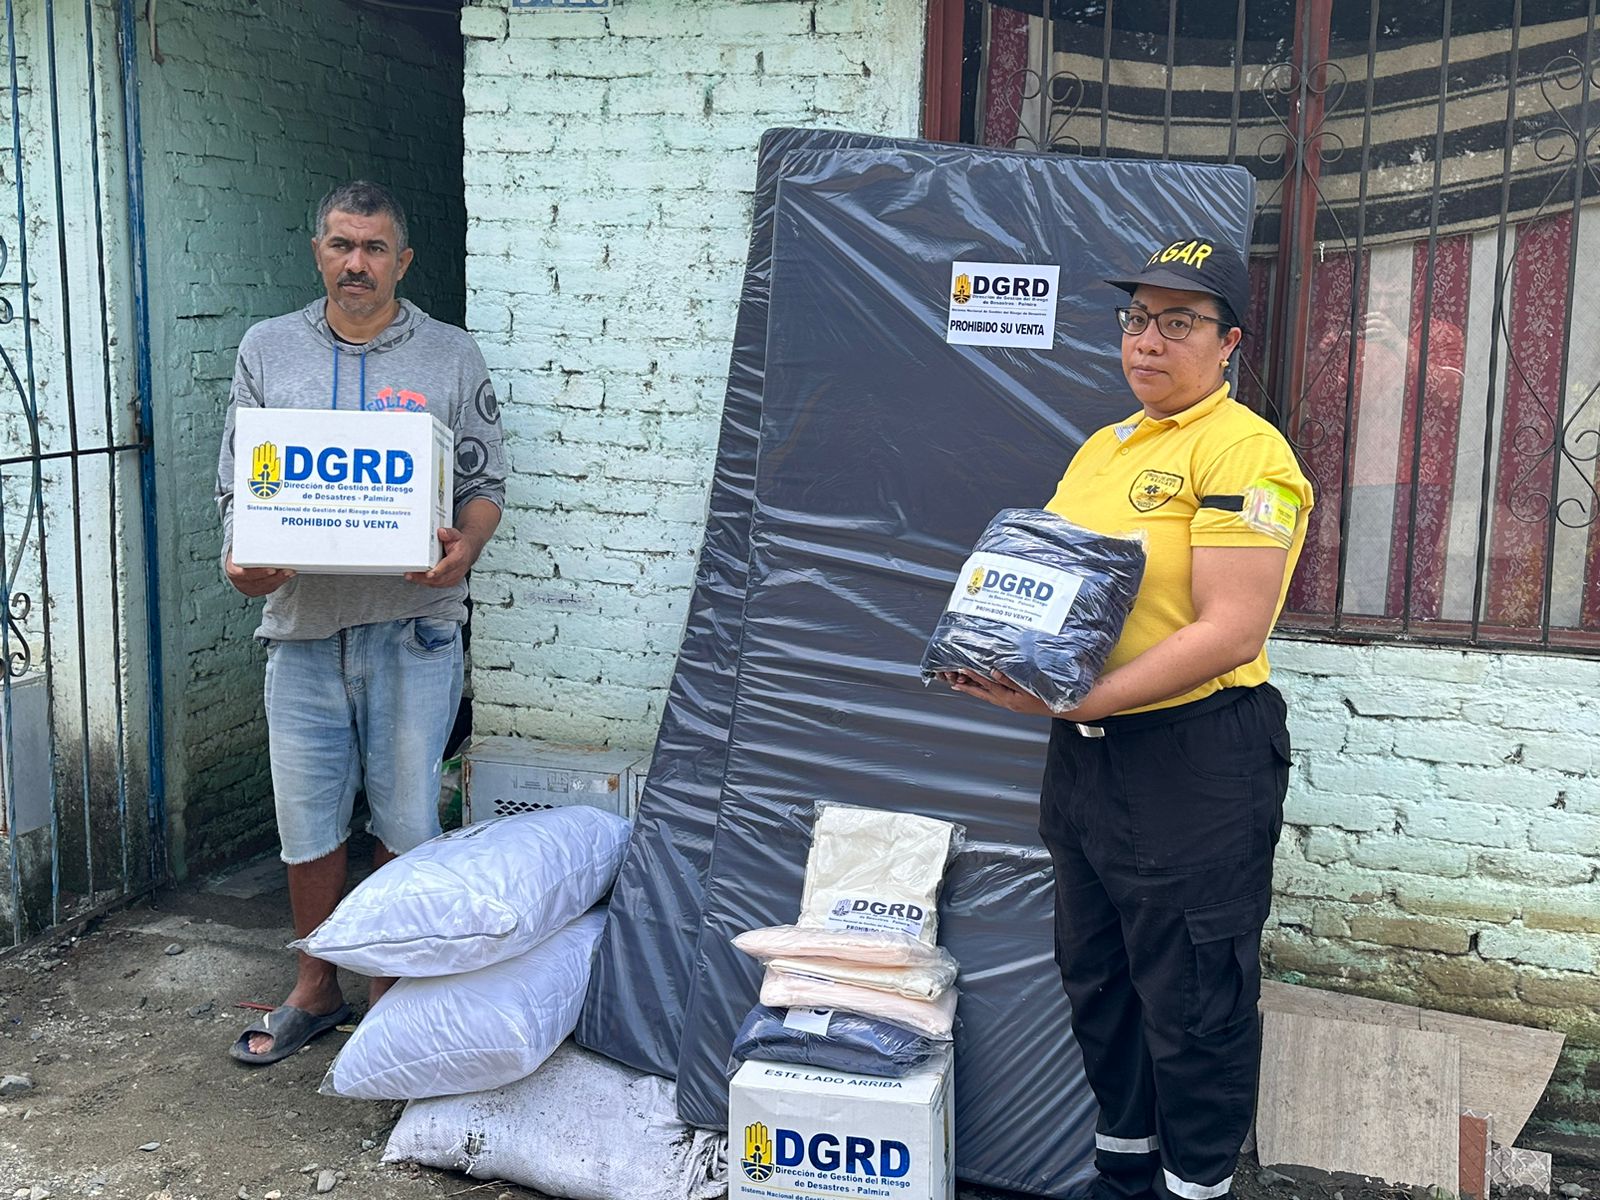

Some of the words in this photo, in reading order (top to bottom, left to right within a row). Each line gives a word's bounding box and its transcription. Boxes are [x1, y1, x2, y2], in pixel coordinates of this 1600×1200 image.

[972, 275, 1050, 298] DGRD
[950, 320, 998, 333] PROHIBIDO
[1000, 322, 1012, 334] SU
[1015, 323, 1044, 336] VENTA
[284, 445, 414, 485] DGRD
[284, 481, 322, 490] Dirección
[386, 486, 414, 494] Riesgo
[282, 517, 342, 527] PROHIBIDO
[346, 518, 360, 528] SU
[364, 520, 399, 529] VENTA
[982, 570, 1054, 602] DGRD
[1013, 613, 1032, 622] VENTA
[852, 899, 923, 920] DGRD
[764, 1069, 802, 1080] ESTE
[804, 1074, 844, 1084] LADO
[847, 1078, 903, 1088] ARRIBA
[776, 1128, 910, 1178] DGRD
[776, 1166, 814, 1178] Dirección
[881, 1178, 910, 1188] Riesgo
[741, 1186, 765, 1195] Sistema
[767, 1190, 794, 1199] Nacional
[808, 1181, 850, 1192] Desastres
[858, 1186, 890, 1196] Palmira
